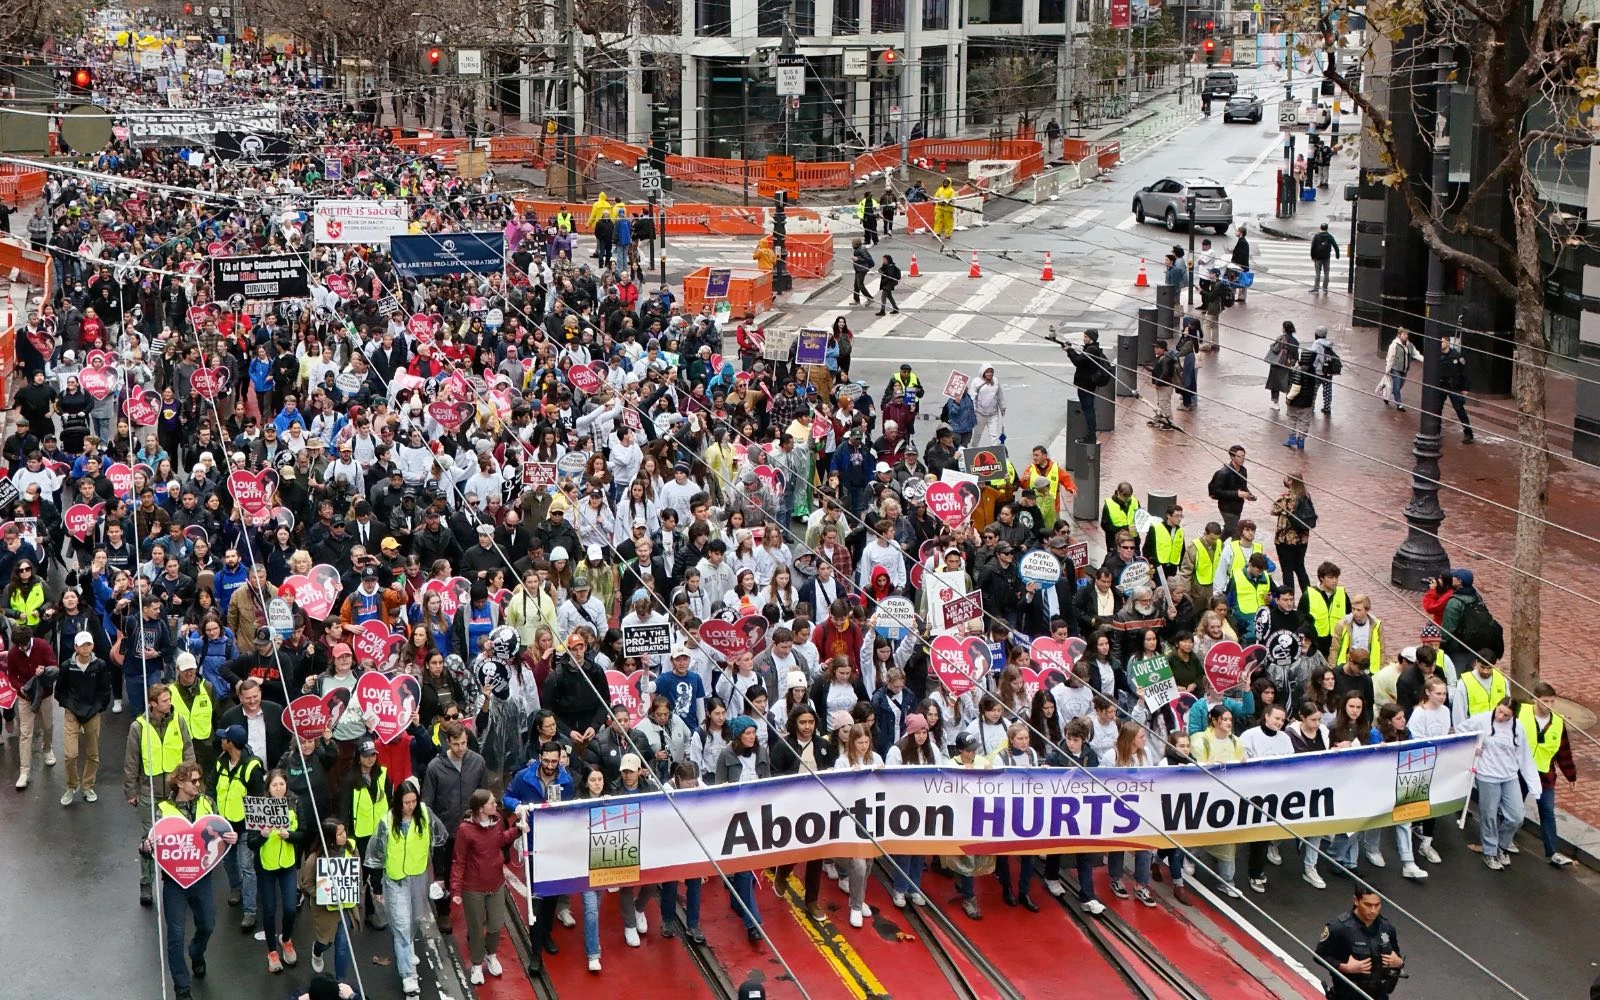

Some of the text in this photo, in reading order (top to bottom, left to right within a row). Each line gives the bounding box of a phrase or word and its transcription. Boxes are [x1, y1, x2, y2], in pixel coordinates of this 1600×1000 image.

[1280, 113, 1297, 122] 20
[642, 178, 660, 188] 20
[356, 206, 364, 216] is
[219, 258, 302, 272] 1/3 of Our Generation has
[222, 272, 238, 282] been
[258, 270, 280, 280] before
[281, 269, 300, 278] birth.
[572, 371, 590, 380] LOVE
[578, 377, 597, 386] BOTH
[110, 474, 132, 482] LOVE
[758, 474, 772, 484] OVE
[114, 482, 132, 490] BOT
[234, 481, 257, 489] LOVE
[236, 490, 262, 498] BOTH
[931, 493, 955, 501] LOVE
[936, 502, 960, 512] BOTH
[70, 514, 94, 522] LOVE
[1034, 552, 1050, 560] PRAY
[1069, 552, 1087, 560] ARTS
[1023, 564, 1058, 574] ABORTION
[1040, 560, 1054, 568] END
[1128, 563, 1142, 572] PRAY
[1135, 568, 1146, 576] END
[440, 591, 450, 600] VE
[440, 602, 456, 611] OTH
[948, 604, 958, 612] LET
[946, 604, 979, 620] HEARTS
[952, 611, 973, 624] BEAT
[362, 629, 386, 648] LOVE
[706, 630, 738, 638] LOVE
[626, 636, 670, 646] PRO-LIFE
[712, 638, 744, 646] BOTH
[358, 640, 385, 662] BOTH
[626, 644, 669, 653] GENERATION
[936, 650, 964, 660] LOVE
[1036, 650, 1064, 660] LOVE
[1212, 653, 1240, 666] LOVE
[940, 664, 970, 674] BOTH
[1132, 656, 1168, 676] LOVE LIFE
[1210, 664, 1240, 676] BOTH
[362, 688, 391, 700] LOVE
[1144, 680, 1173, 698] CHOOSE
[1156, 692, 1170, 706] LIFE
[292, 706, 322, 718] LOVE
[366, 702, 398, 716] BOTH
[293, 716, 326, 727] BOTH
[1398, 770, 1427, 786] Walk
[922, 776, 1156, 795] Walk for Life West Coast
[1404, 784, 1428, 800] Life
[244, 796, 287, 806] EVERY CHILD
[245, 805, 254, 814] IS
[263, 805, 288, 816] GIFT
[246, 815, 290, 826] FROM GOD
[721, 786, 1334, 856] Abortion HURTS Women
[158, 834, 194, 846] LOVE
[592, 830, 630, 846] Walk
[162, 848, 200, 860] BOTH
[602, 842, 638, 862] Life
[318, 858, 358, 876] LOVE
[331, 886, 359, 902] BOTH
